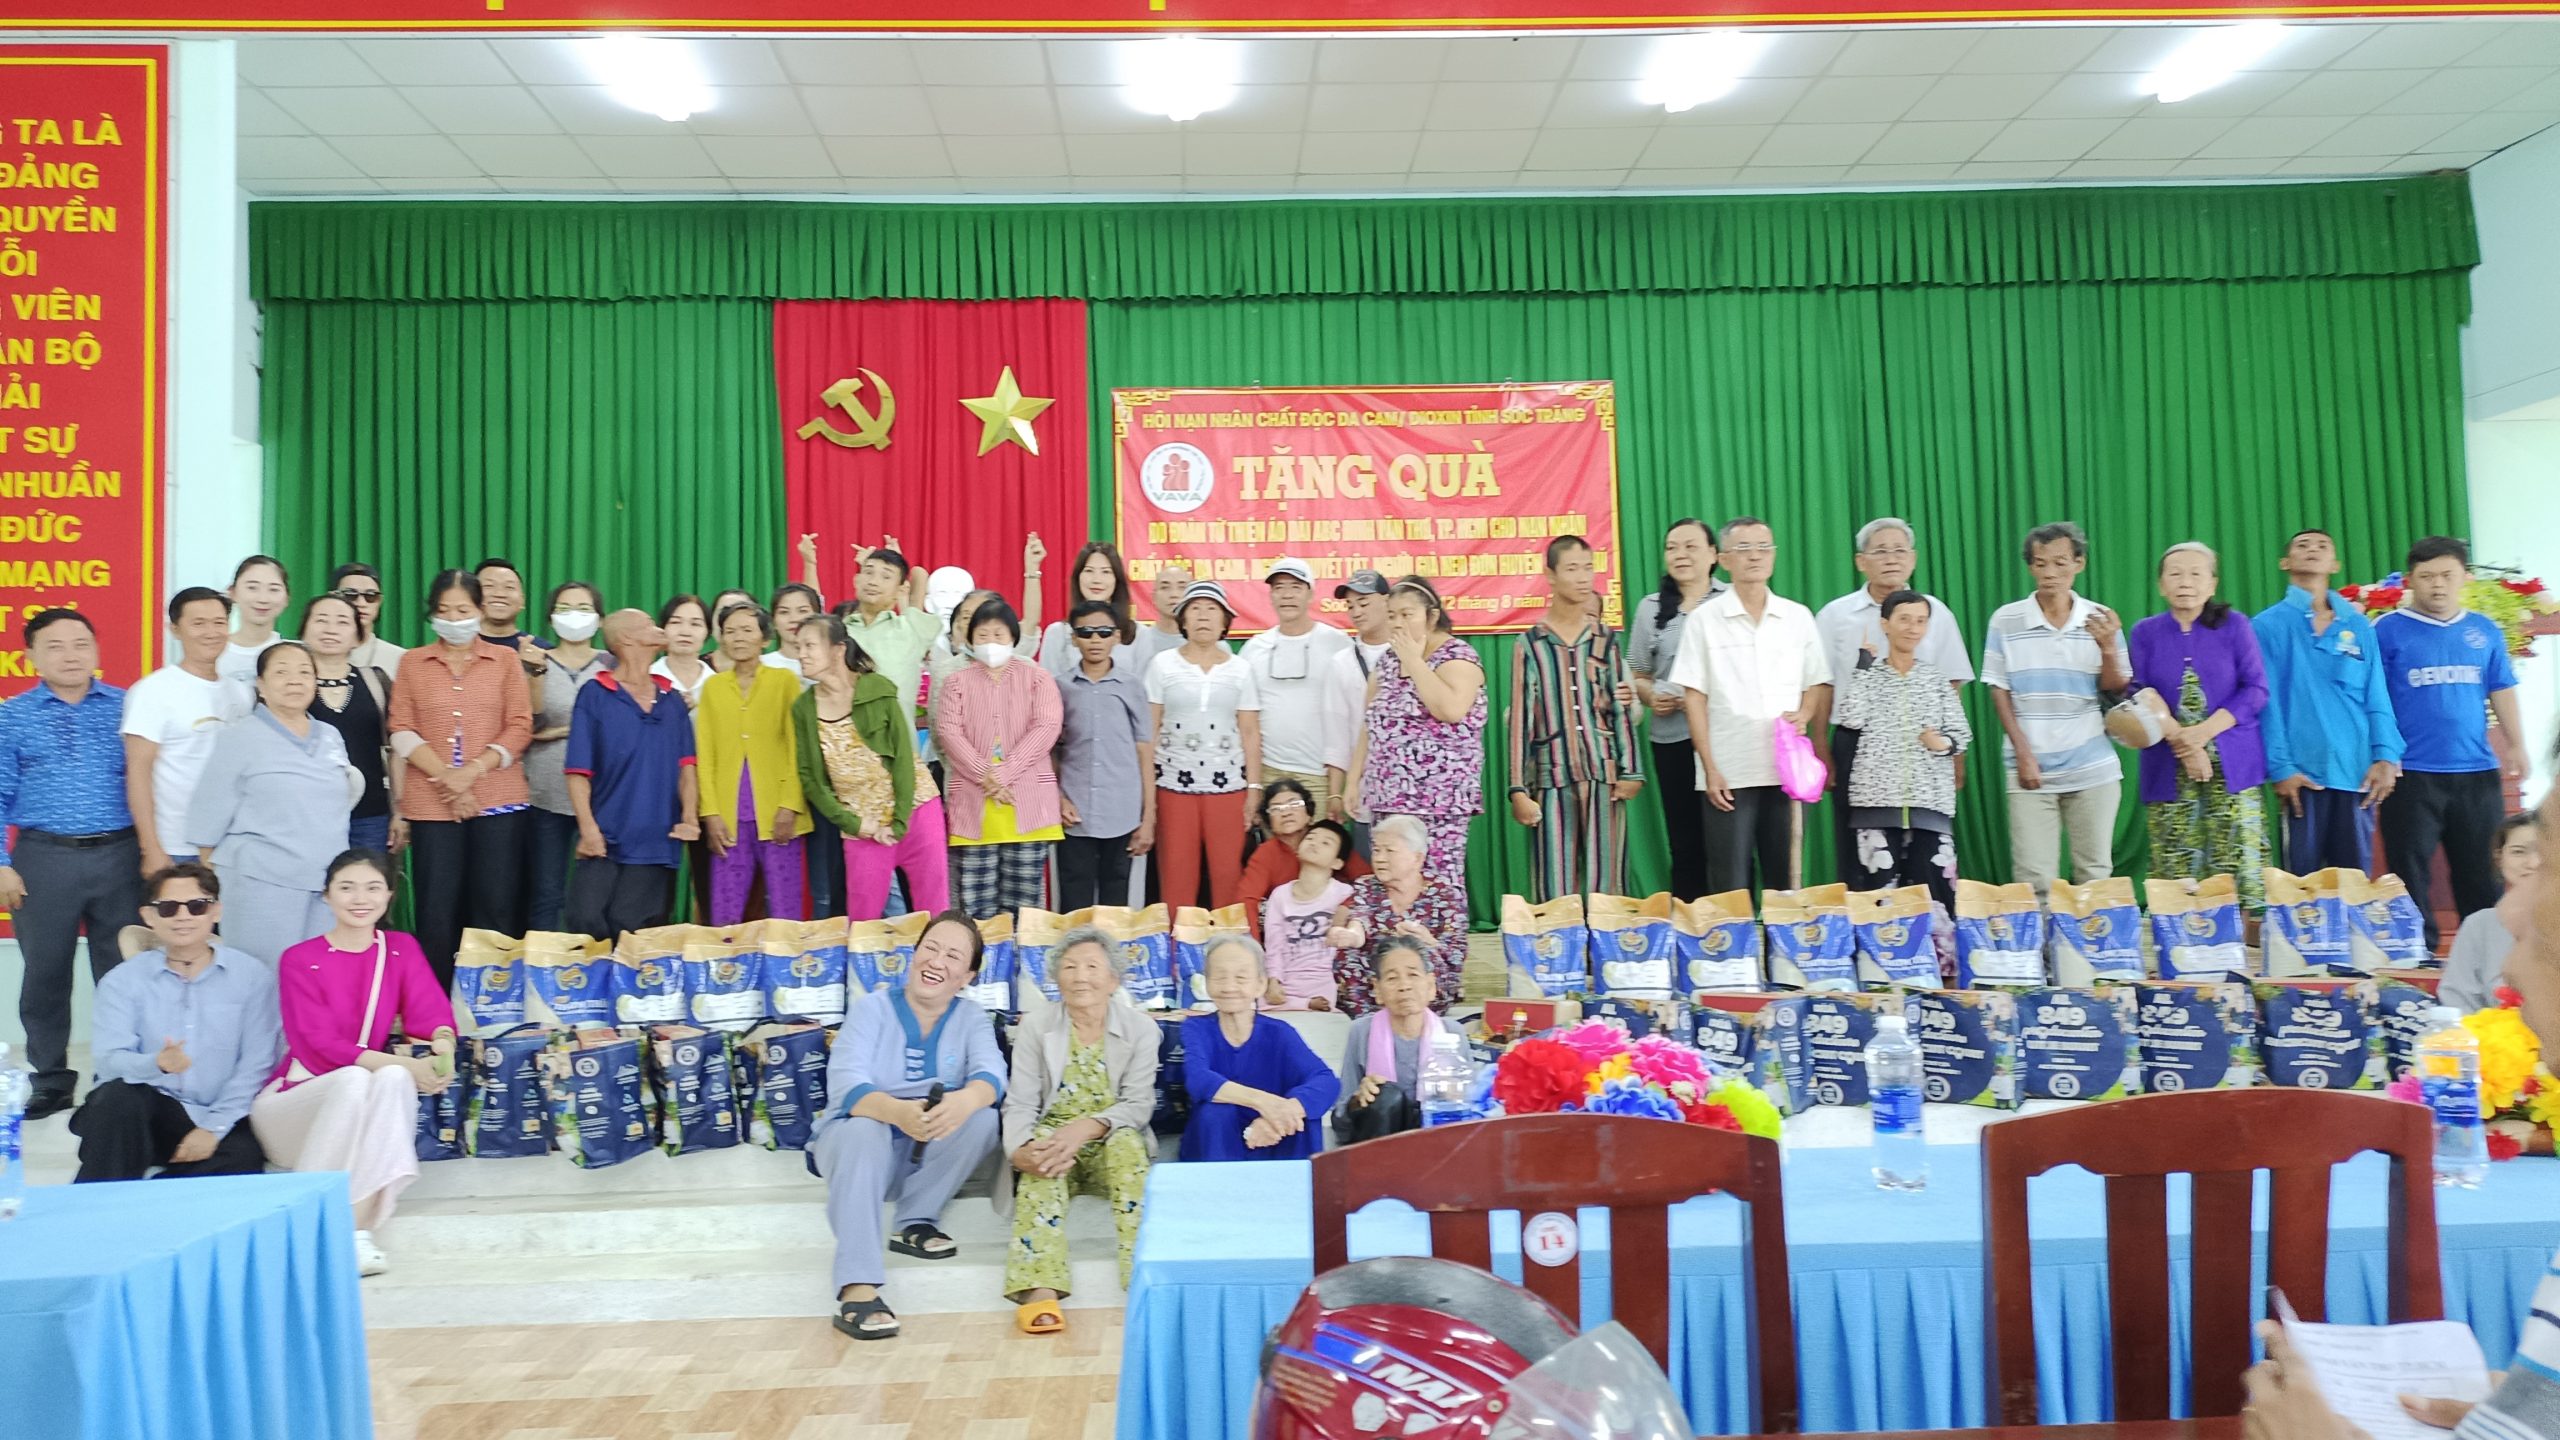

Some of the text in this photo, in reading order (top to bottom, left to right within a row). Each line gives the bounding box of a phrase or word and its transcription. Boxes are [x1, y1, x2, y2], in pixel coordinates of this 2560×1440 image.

[12, 112, 123, 146] TA LÀ
[11, 287, 102, 321] VIÊN
[45, 331, 102, 370] BỘ
[0, 372, 41, 409] ẢI
[1143, 410, 1171, 431] HỘI
[1174, 413, 1207, 432] NẠN
[1210, 409, 1253, 428] NHÂN
[1256, 406, 1297, 427] CHẤT
[1300, 408, 1335, 430] ĐỘC
[1338, 411, 1360, 427] DA
[1464, 405, 1498, 425] TỈNH
[1536, 404, 1588, 423] TRĂNG
[23, 423, 80, 458] SỰ
[1233, 445, 1377, 511] TẶNG
[1388, 439, 1501, 501] QUÀ
[1152, 492, 1203, 501] VAVA
[0, 508, 83, 543] ĐỨC
[0, 559, 111, 592] MẠNG
[1501, 594, 1512, 608] 8
